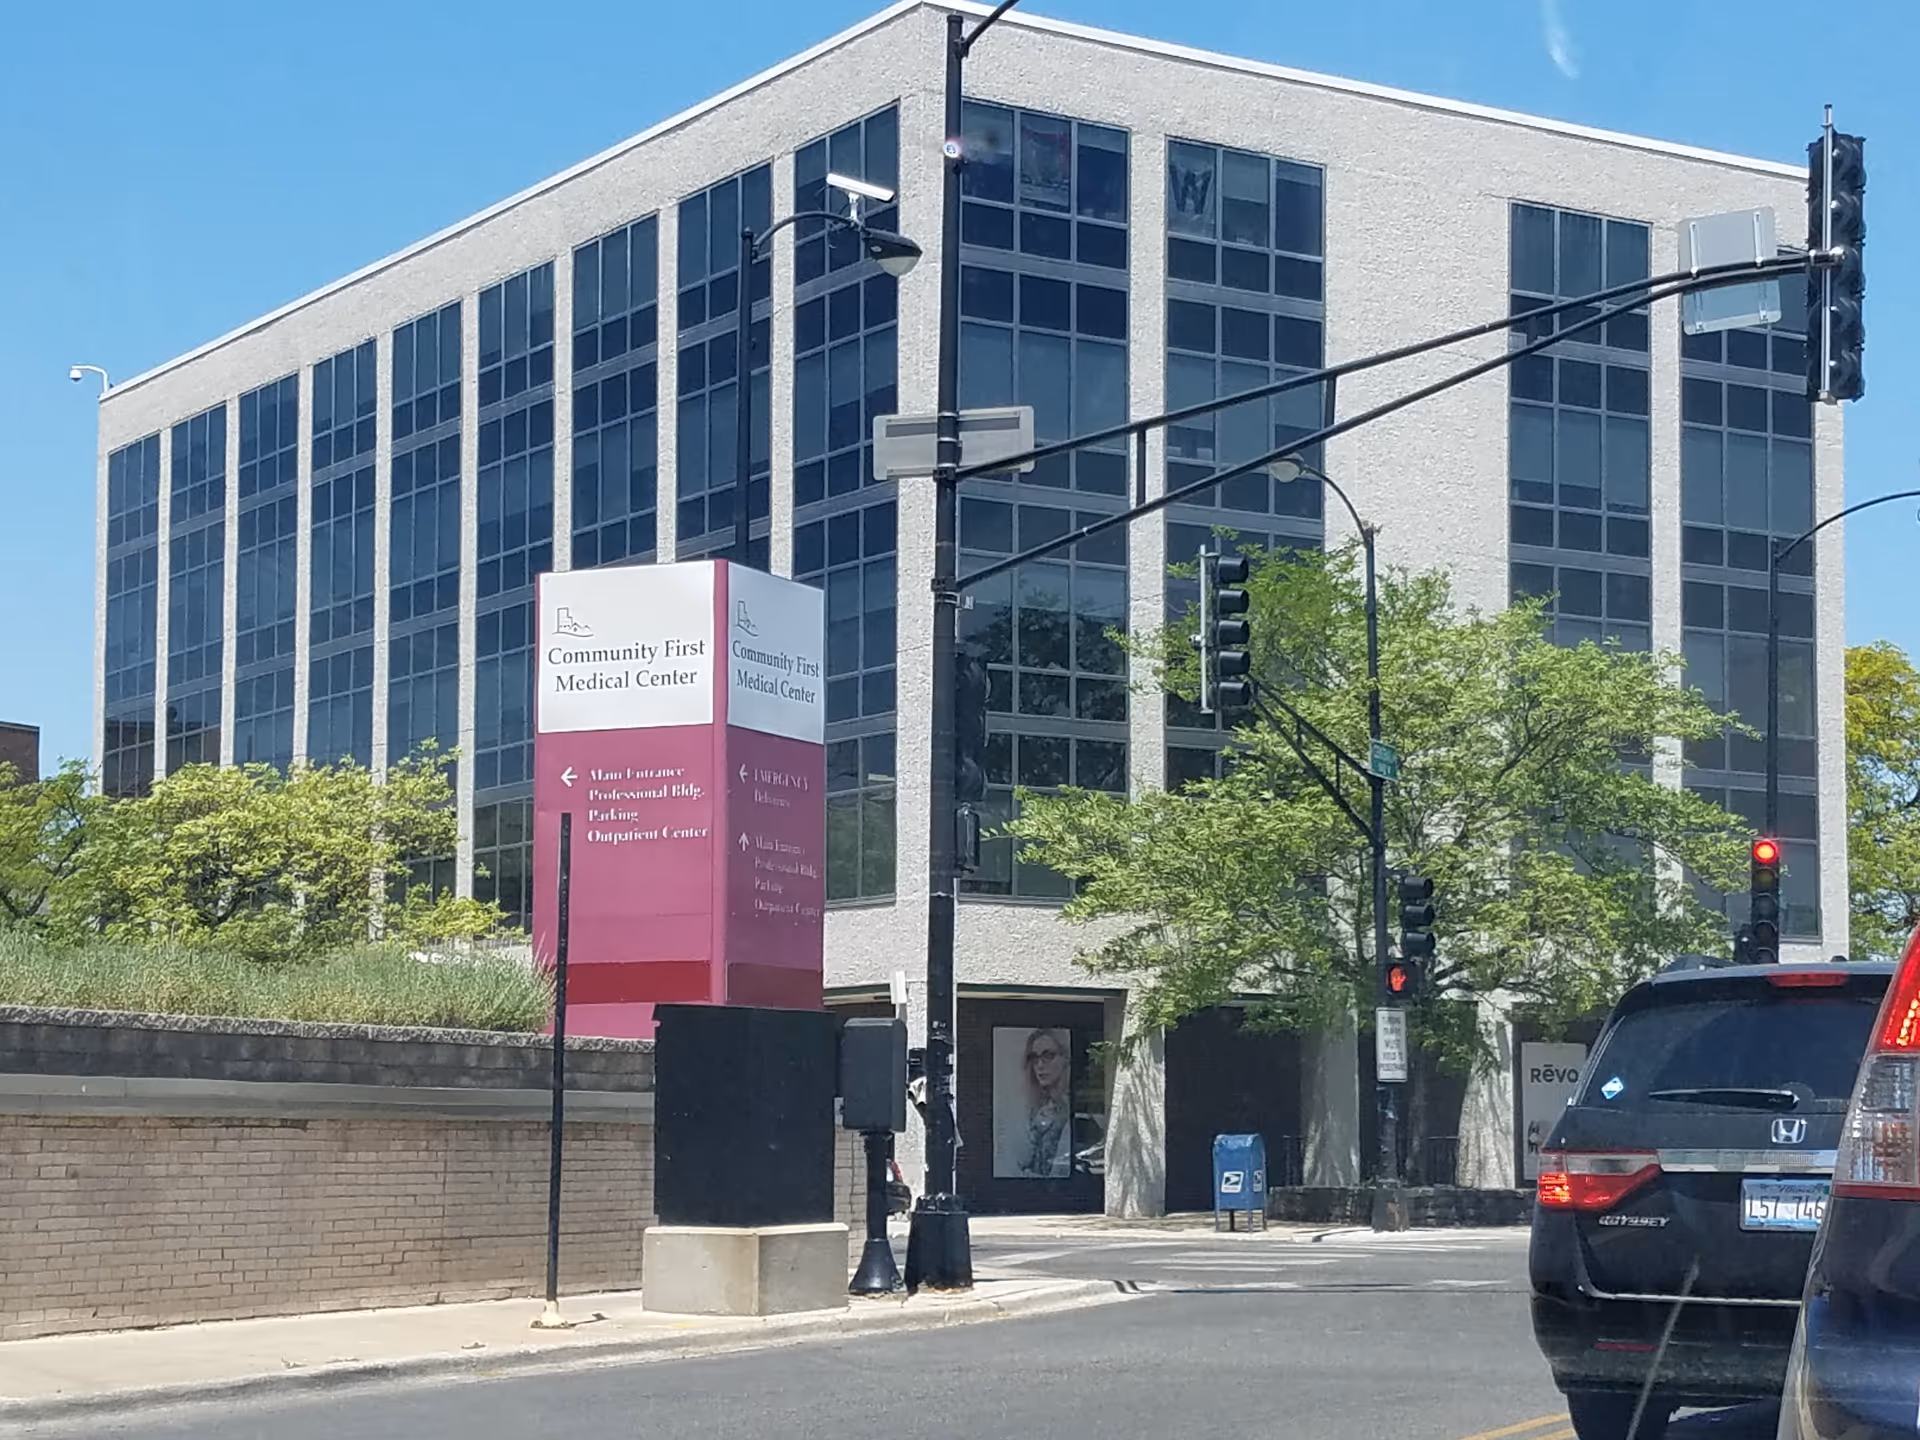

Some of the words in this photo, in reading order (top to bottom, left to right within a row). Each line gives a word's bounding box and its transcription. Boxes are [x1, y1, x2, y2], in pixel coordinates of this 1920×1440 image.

[548, 642, 659, 665] Community
[665, 639, 706, 657] First
[732, 640, 794, 676] Community
[796, 657, 820, 678] First
[555, 671, 630, 692] Medical
[636, 669, 698, 687] Center
[736, 668, 778, 696] Medical
[780, 681, 816, 704] Center
[754, 768, 809, 791] EMERGENCY
[589, 784, 668, 801] Professional
[672, 782, 705, 800] Bldg.
[588, 808, 639, 823] Parking
[588, 828, 658, 845] Outpatient
[662, 825, 708, 838] Center
